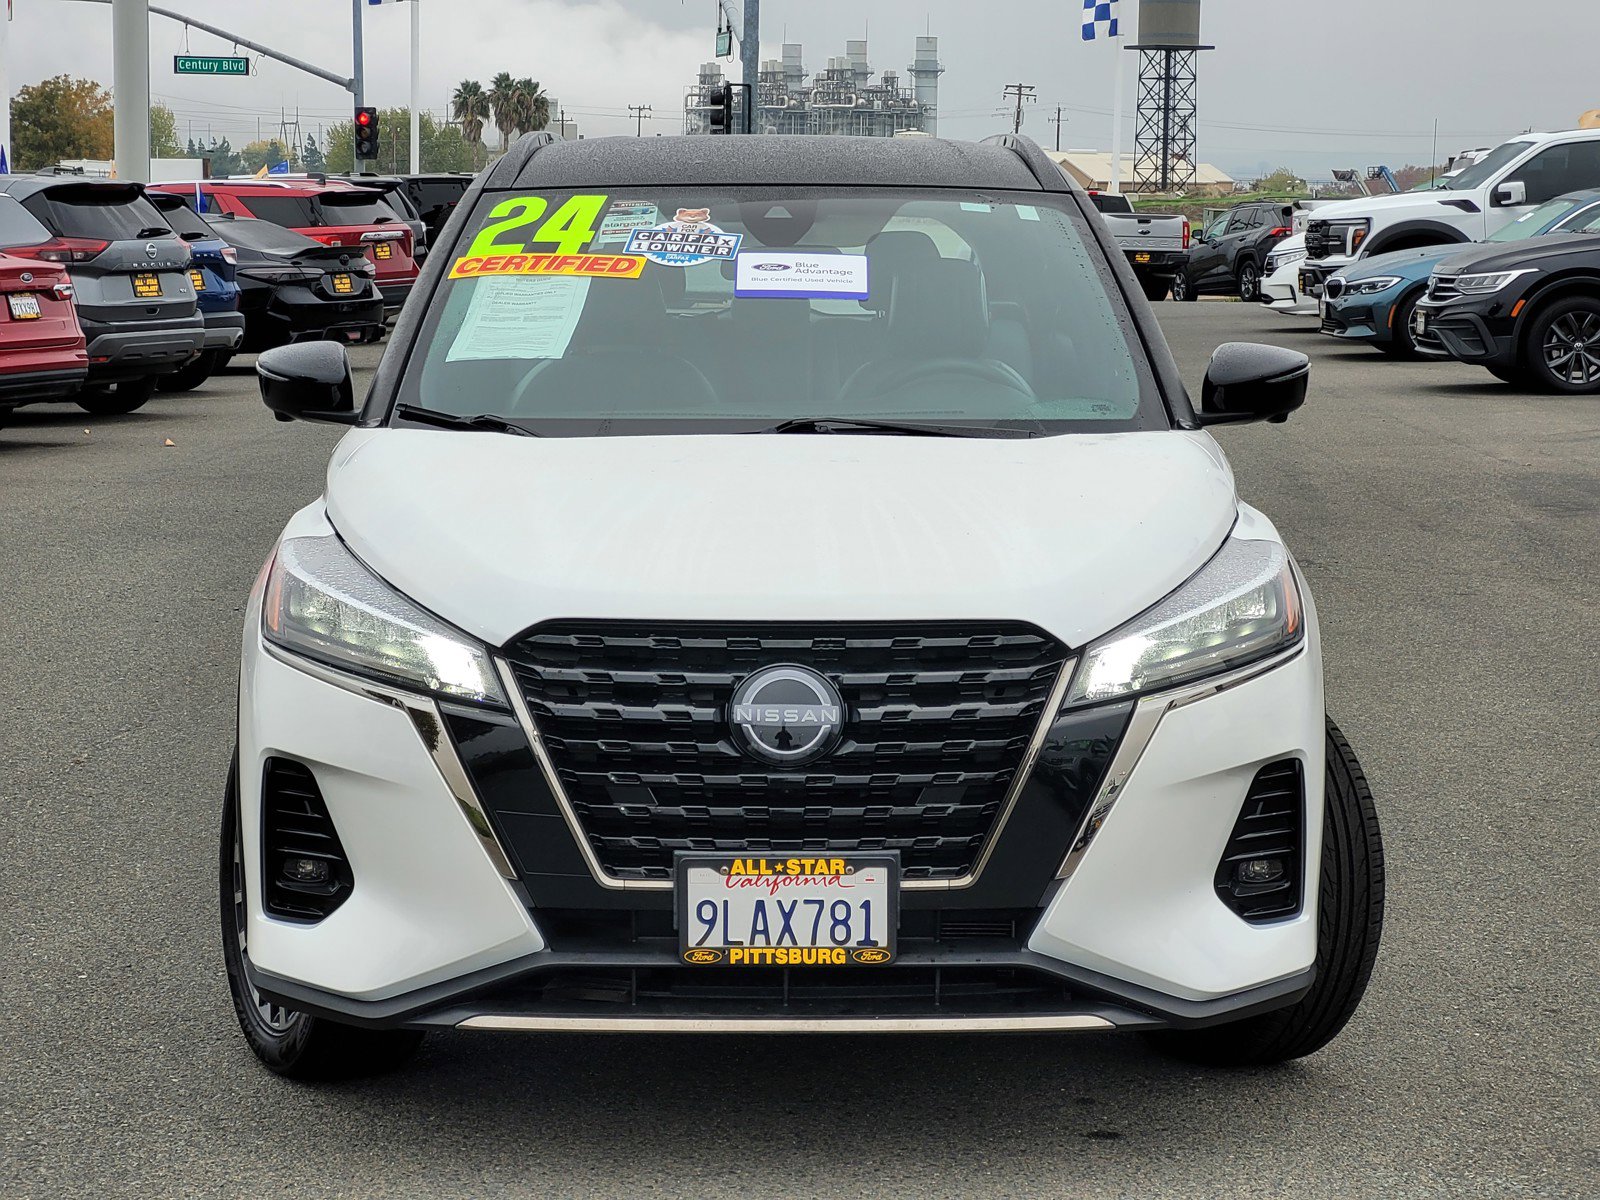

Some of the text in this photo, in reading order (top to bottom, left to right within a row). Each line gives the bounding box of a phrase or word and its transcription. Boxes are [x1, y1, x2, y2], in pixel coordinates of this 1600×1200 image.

[179, 59, 244, 73] Century Blvd
[466, 195, 608, 256] 24
[637, 232, 733, 246] CARFAX
[1119, 239, 1181, 247] ANGER
[634, 242, 730, 256] 1 OWNER
[455, 255, 641, 274] CERTIFIED
[794, 268, 853, 276] Advantage
[736, 708, 836, 722] NISSAN
[730, 859, 845, 875] ALL STAR
[725, 874, 855, 896] California
[695, 899, 879, 947] 9LAX781
[692, 951, 715, 961] Ford
[729, 948, 846, 965] PITTSBURG
[860, 951, 883, 961] Ford
